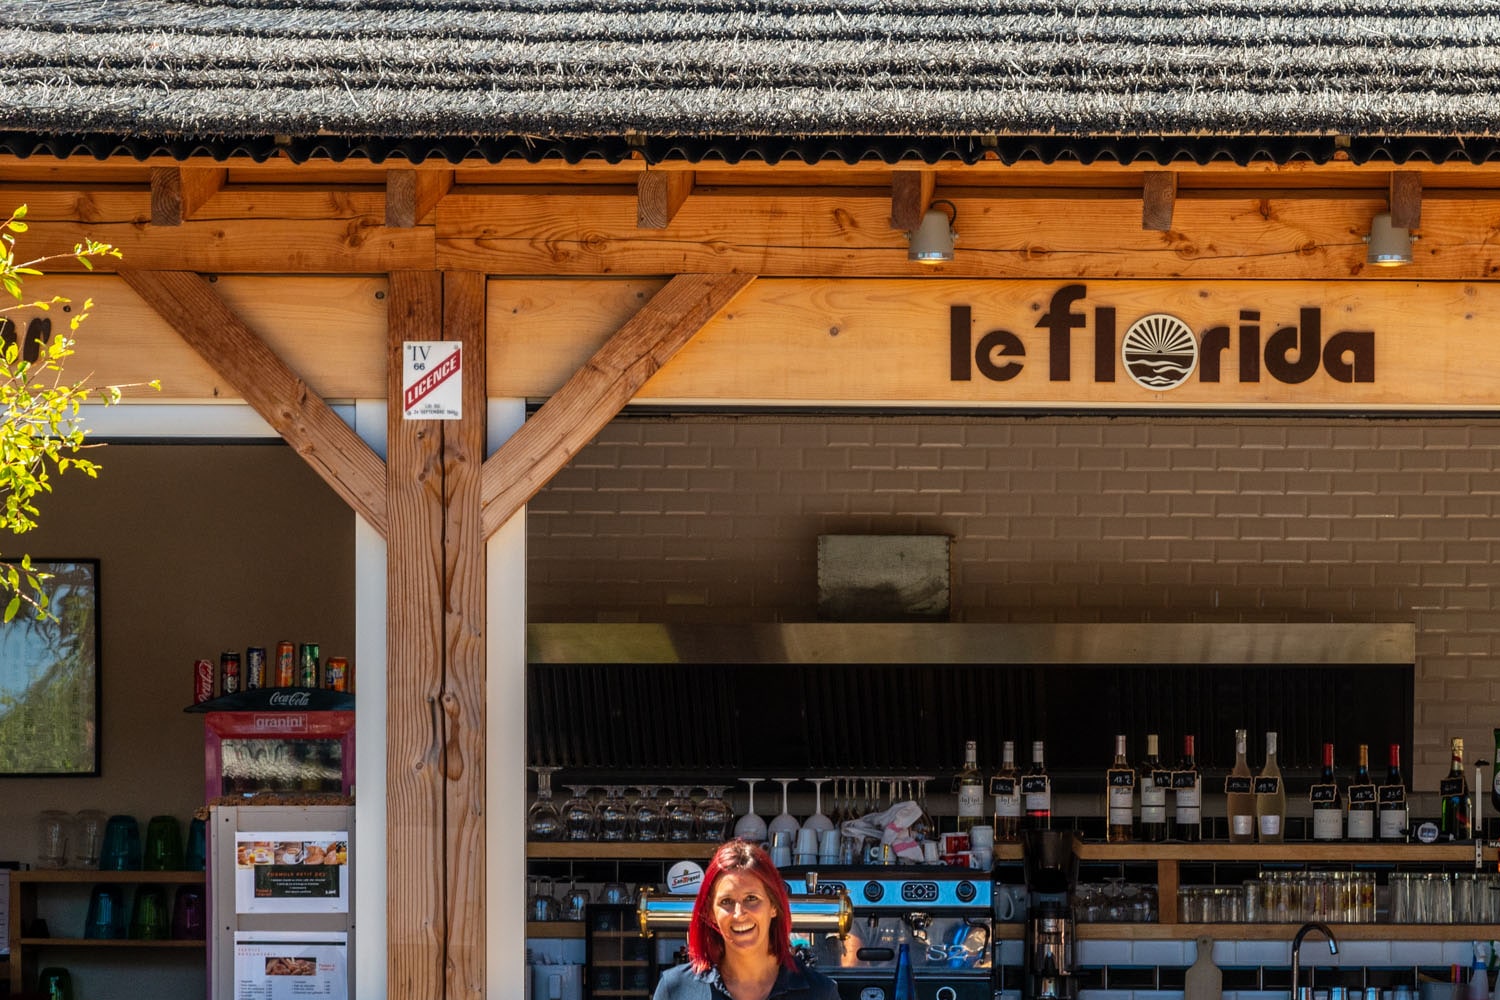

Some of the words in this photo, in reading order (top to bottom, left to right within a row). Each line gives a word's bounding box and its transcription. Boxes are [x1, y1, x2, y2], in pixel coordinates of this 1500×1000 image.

[412, 345, 432, 361] IV
[413, 362, 426, 371] 66
[407, 355, 457, 405] LICENCE
[256, 716, 303, 729] granini
